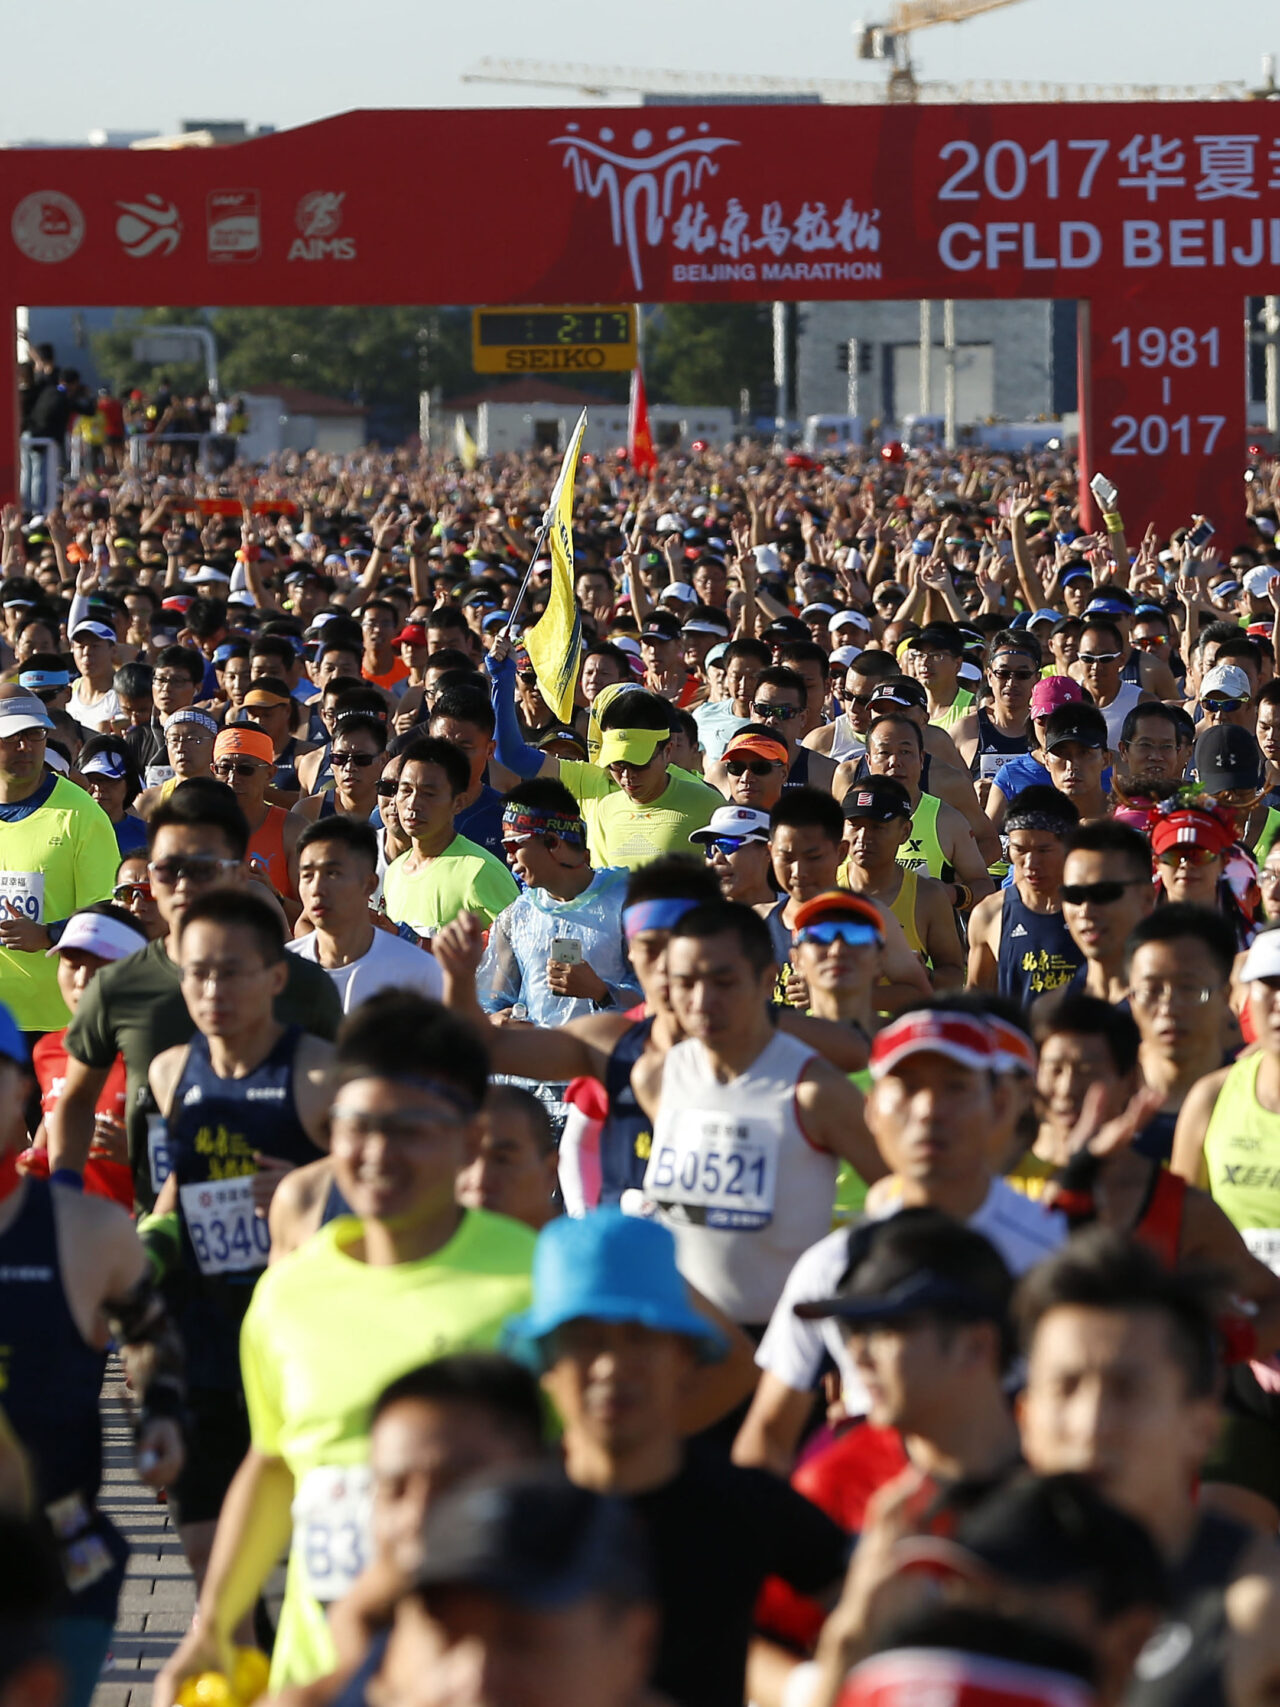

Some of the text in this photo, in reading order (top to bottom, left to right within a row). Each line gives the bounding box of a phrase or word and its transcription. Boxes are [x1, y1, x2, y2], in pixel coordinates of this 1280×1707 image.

[672, 198, 882, 259] 北京马拉松
[938, 221, 1102, 271] CFLD
[287, 238, 356, 261] AIMS
[673, 262, 883, 282] BEIJING MARATHON
[505, 348, 606, 370] SEIKO
[1111, 326, 1219, 368] 1981
[1110, 414, 1227, 455] 2017
[653, 1147, 766, 1197] B0521
